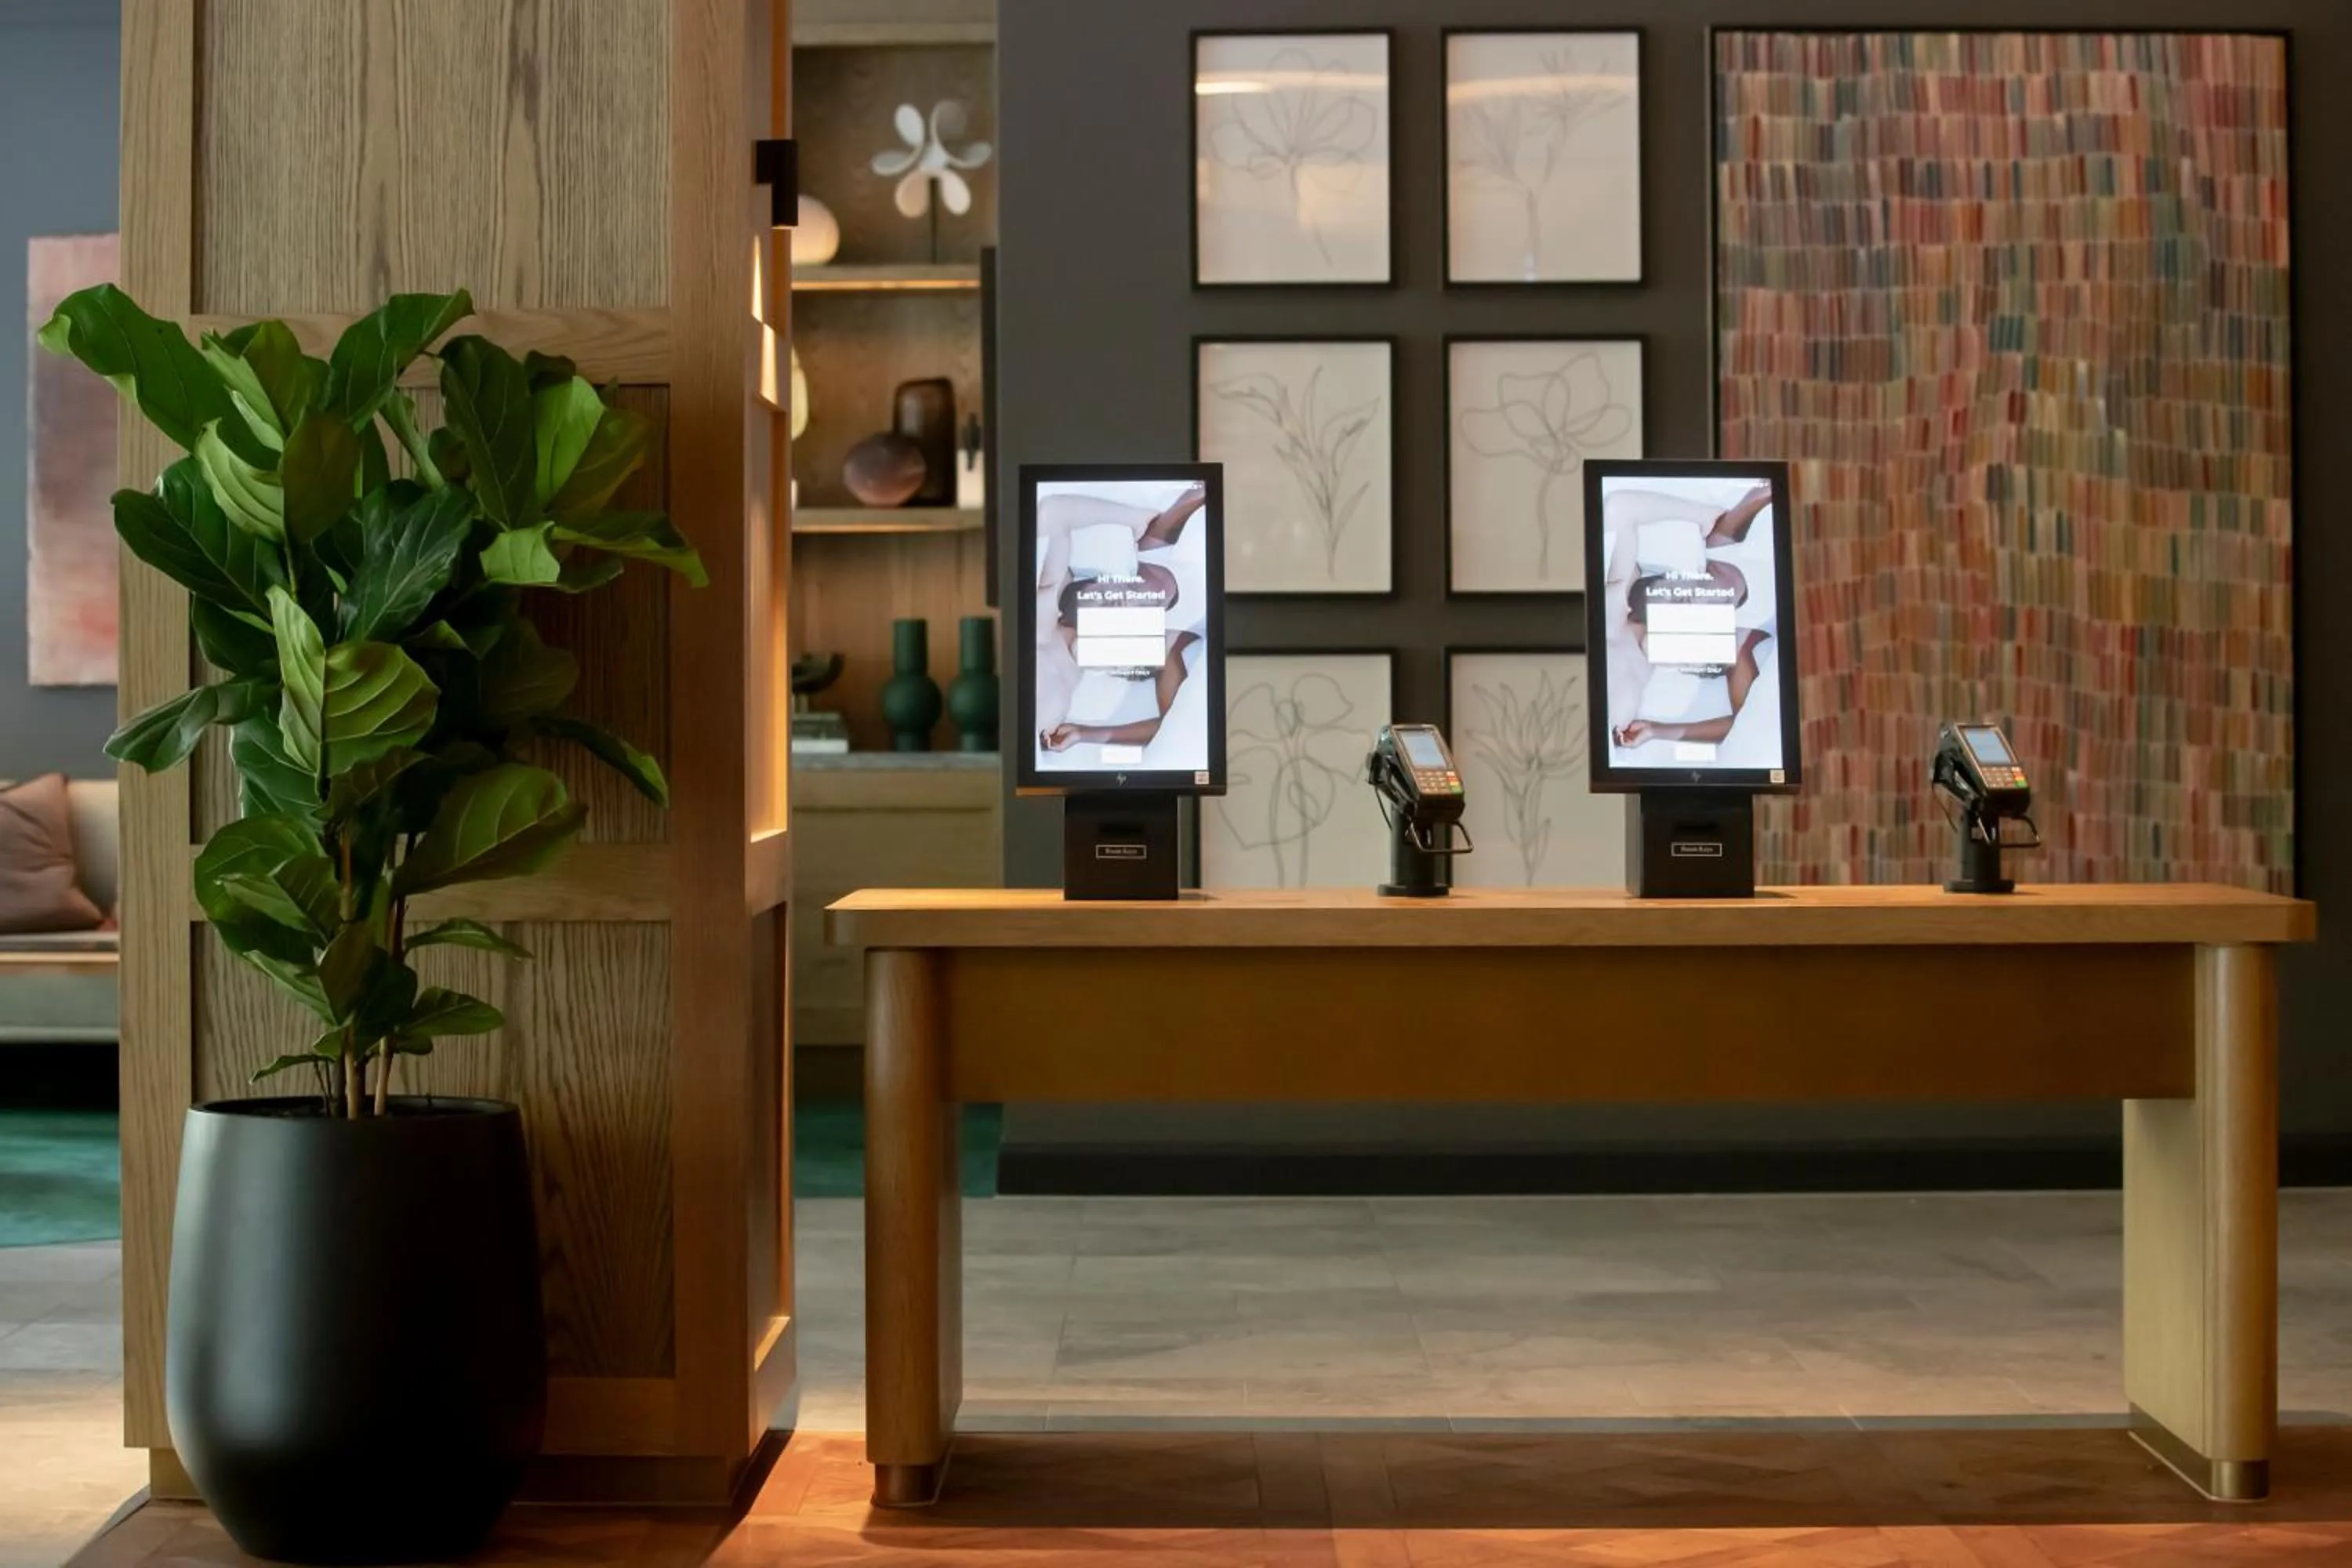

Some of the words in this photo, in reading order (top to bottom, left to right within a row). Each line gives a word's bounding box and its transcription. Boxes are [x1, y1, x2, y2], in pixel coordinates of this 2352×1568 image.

[1077, 590, 1102, 600] Let's
[1104, 590, 1123, 600] Get
[1126, 589, 1166, 600] Started
[1646, 586, 1671, 597] Let's
[1673, 586, 1692, 597] Get
[1694, 586, 1734, 597] Started
